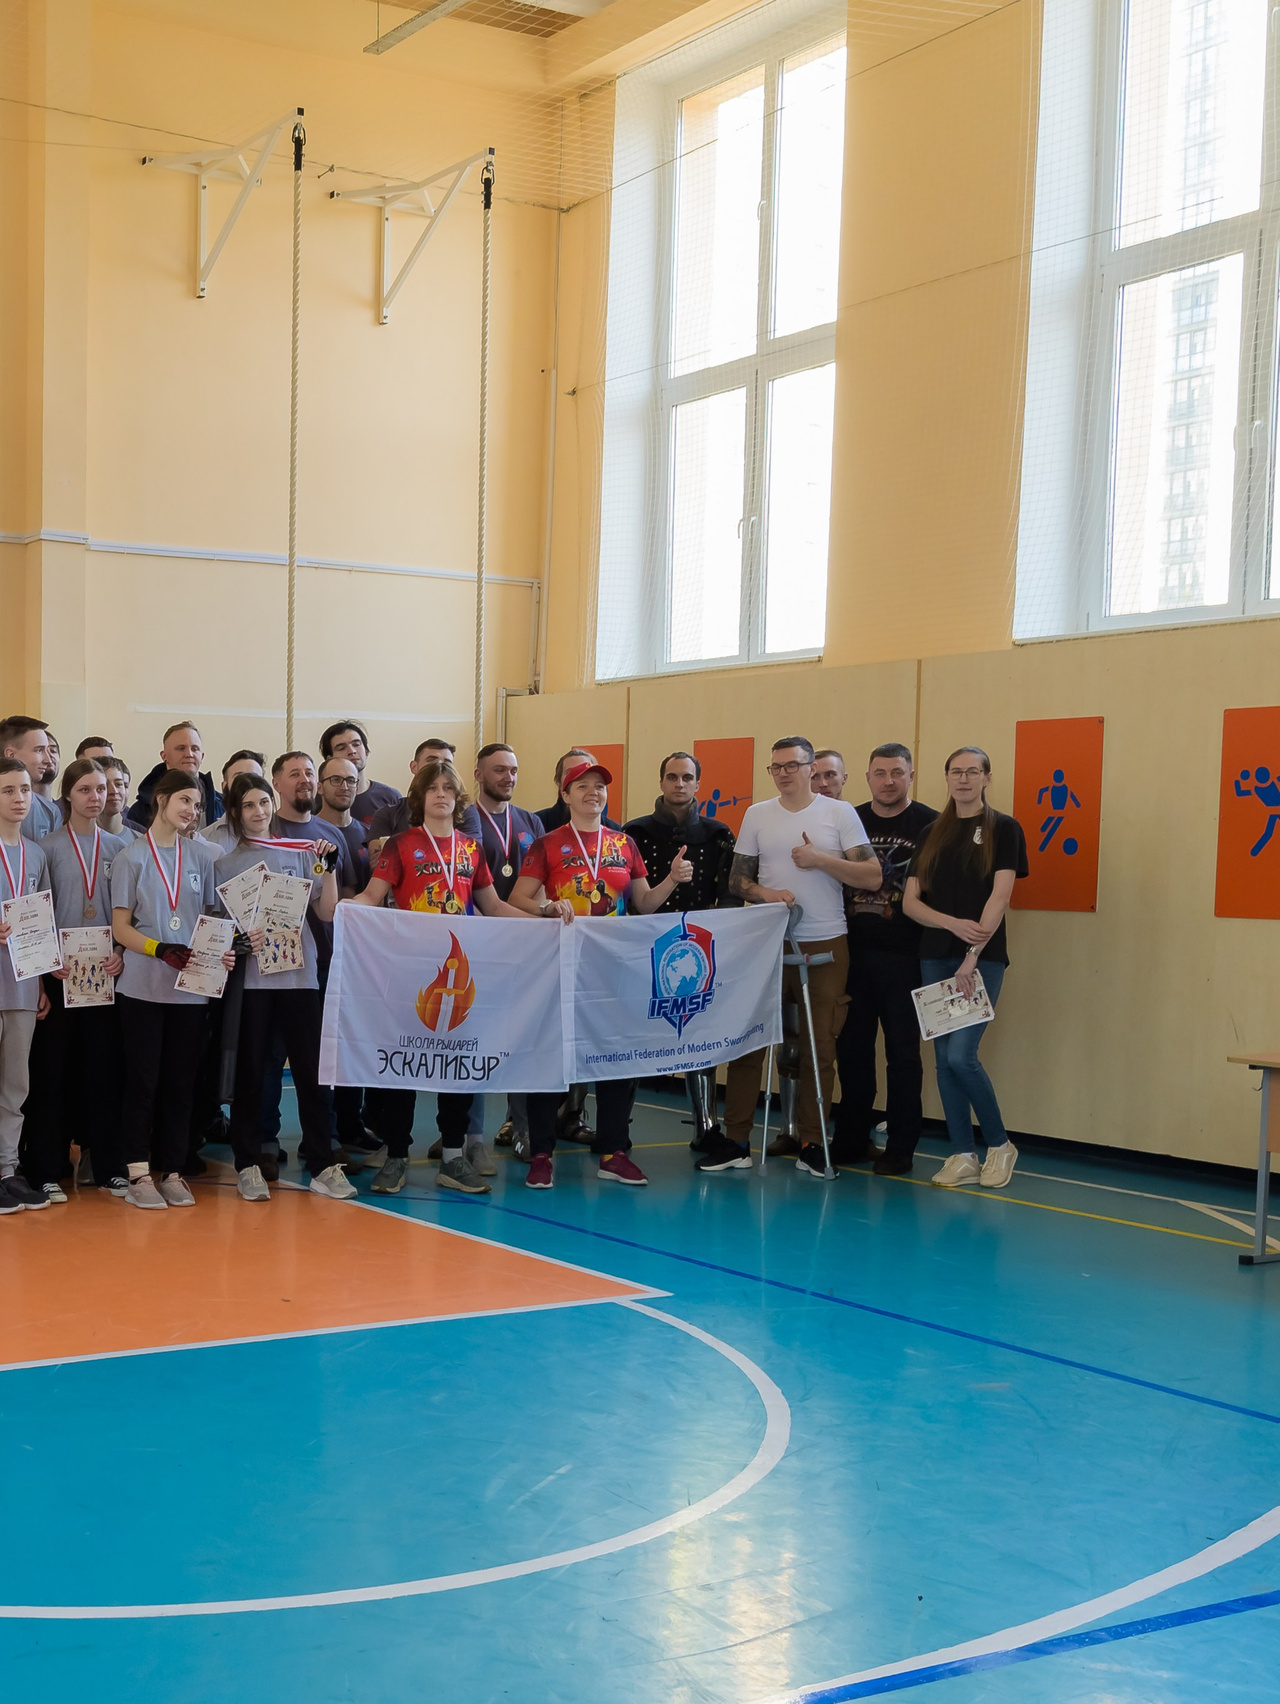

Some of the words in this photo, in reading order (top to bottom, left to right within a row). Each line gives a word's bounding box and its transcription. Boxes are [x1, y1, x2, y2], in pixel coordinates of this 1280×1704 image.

[648, 989, 715, 1019] IFMSF
[399, 1035, 435, 1050] ШКОЛА
[435, 1037, 478, 1052] РЫЦАРЕЙ
[585, 1049, 633, 1065] International
[634, 1046, 675, 1060] Federation
[676, 1043, 686, 1055] of
[687, 1040, 722, 1054] Modern
[377, 1048, 500, 1081] ЭСКАЛИБУР
